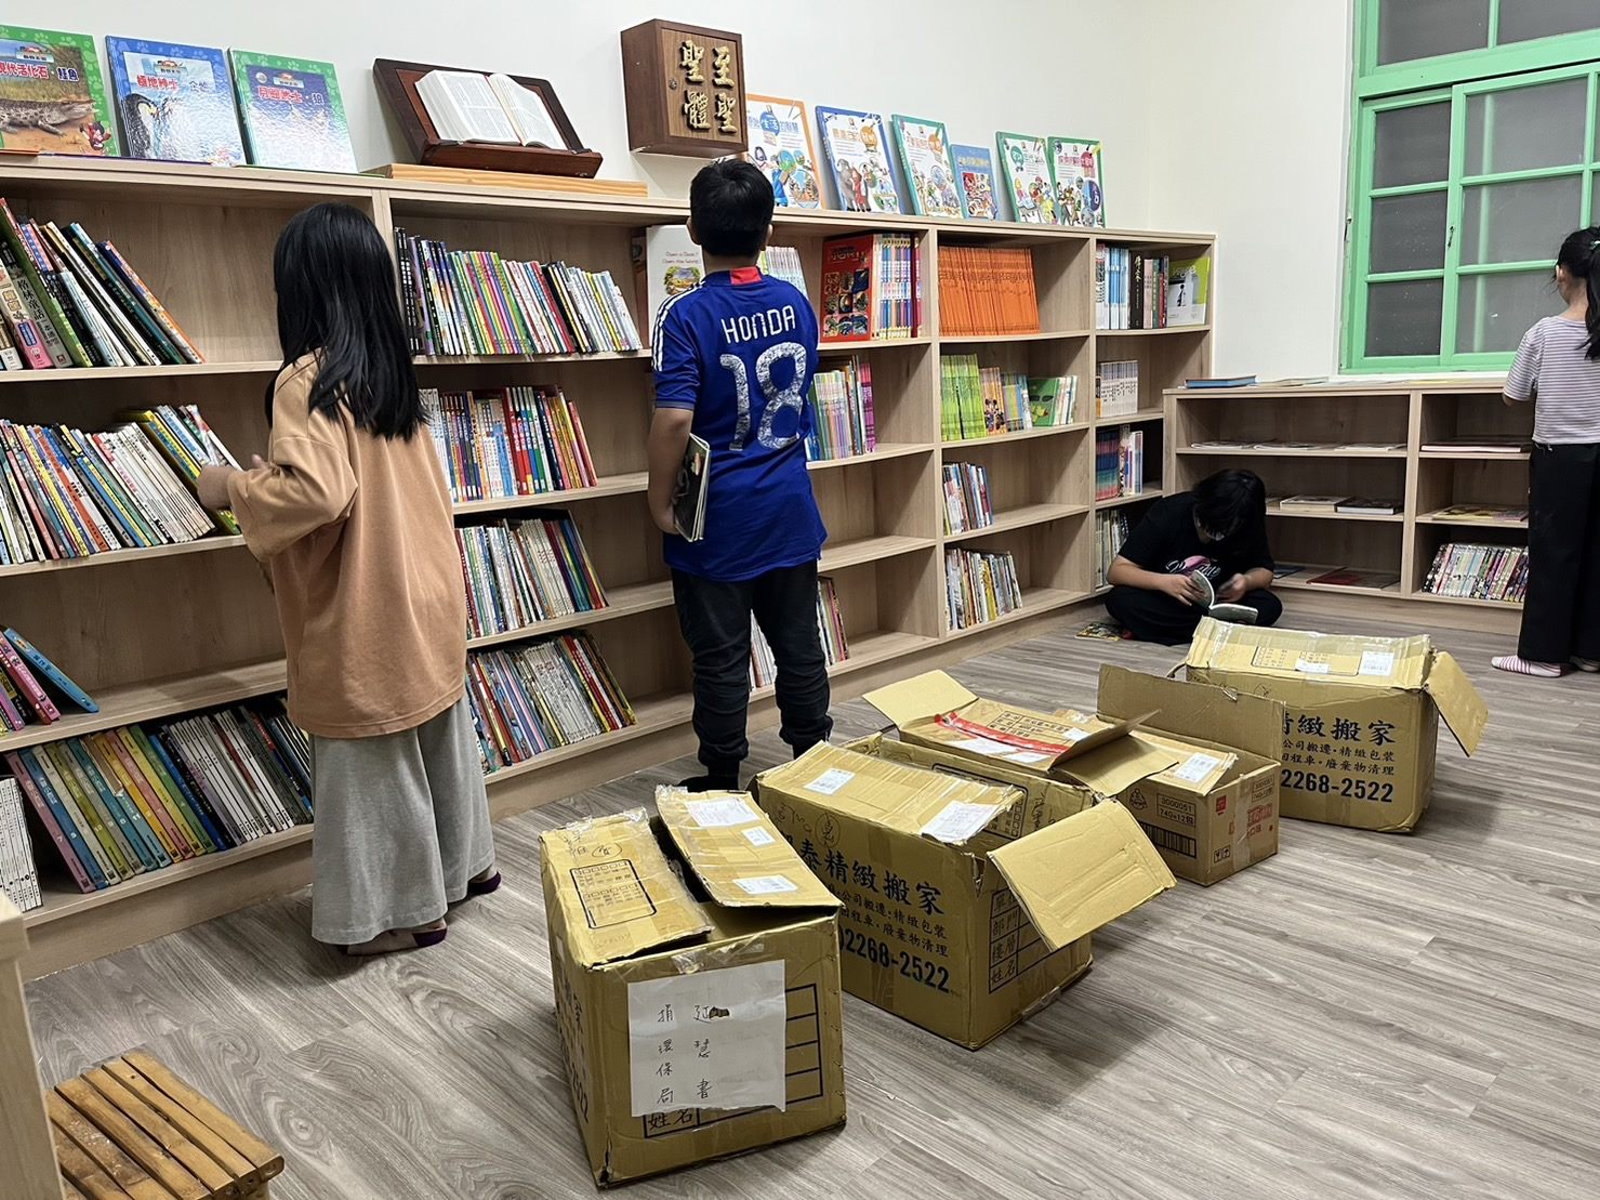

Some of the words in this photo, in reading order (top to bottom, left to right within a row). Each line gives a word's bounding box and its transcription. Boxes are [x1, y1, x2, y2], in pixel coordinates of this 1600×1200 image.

[680, 40, 710, 130] 聖體
[711, 46, 738, 132] 至聖
[721, 305, 795, 344] HONDA
[719, 341, 806, 451] 18
[1280, 769, 1394, 803] 2268-2522
